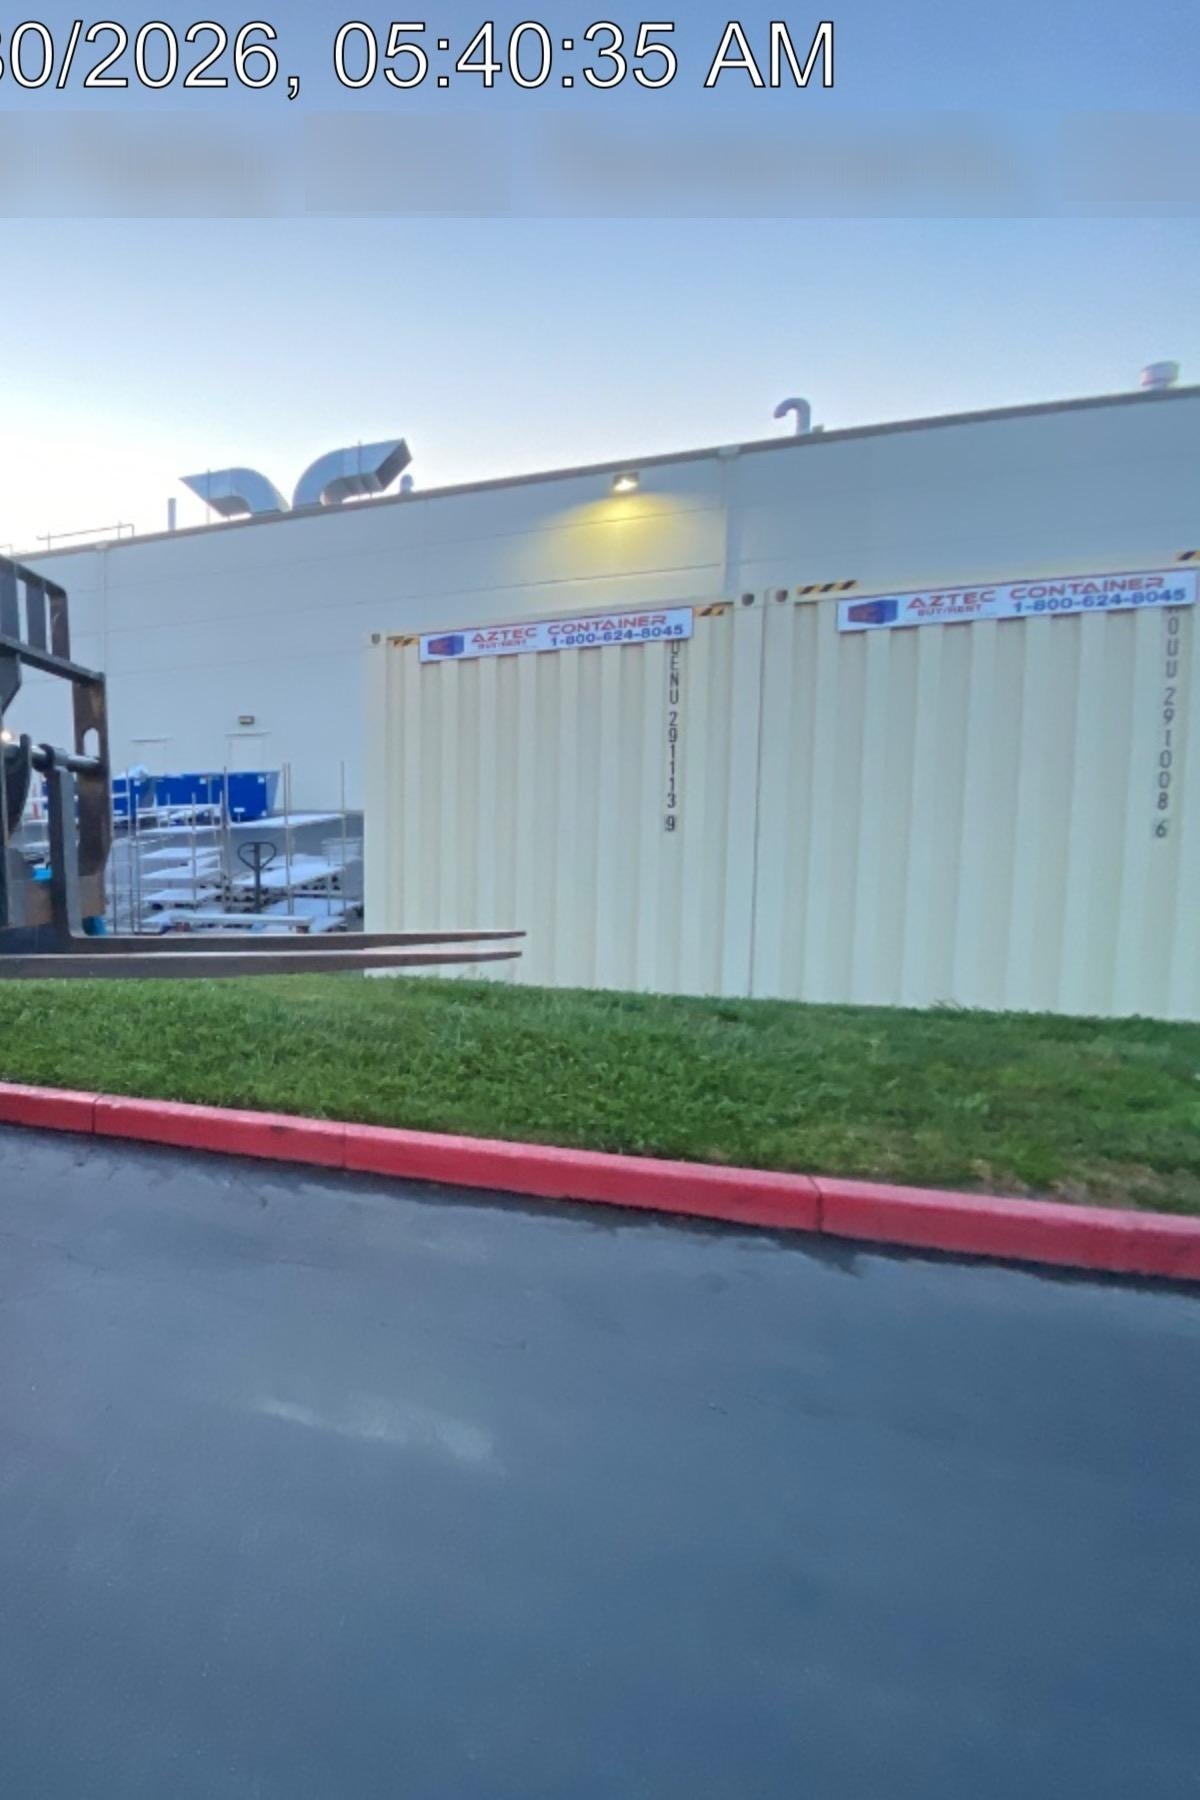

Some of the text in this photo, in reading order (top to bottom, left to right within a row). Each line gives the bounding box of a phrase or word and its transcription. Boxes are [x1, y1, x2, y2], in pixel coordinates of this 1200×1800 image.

[907, 577, 1165, 609] AZTEC CONTAINER
[1014, 587, 1186, 612] 1-800-624-8045
[471, 615, 667, 643] AZTEC CONTAINER
[551, 624, 683, 646] 1-800-624-8045
